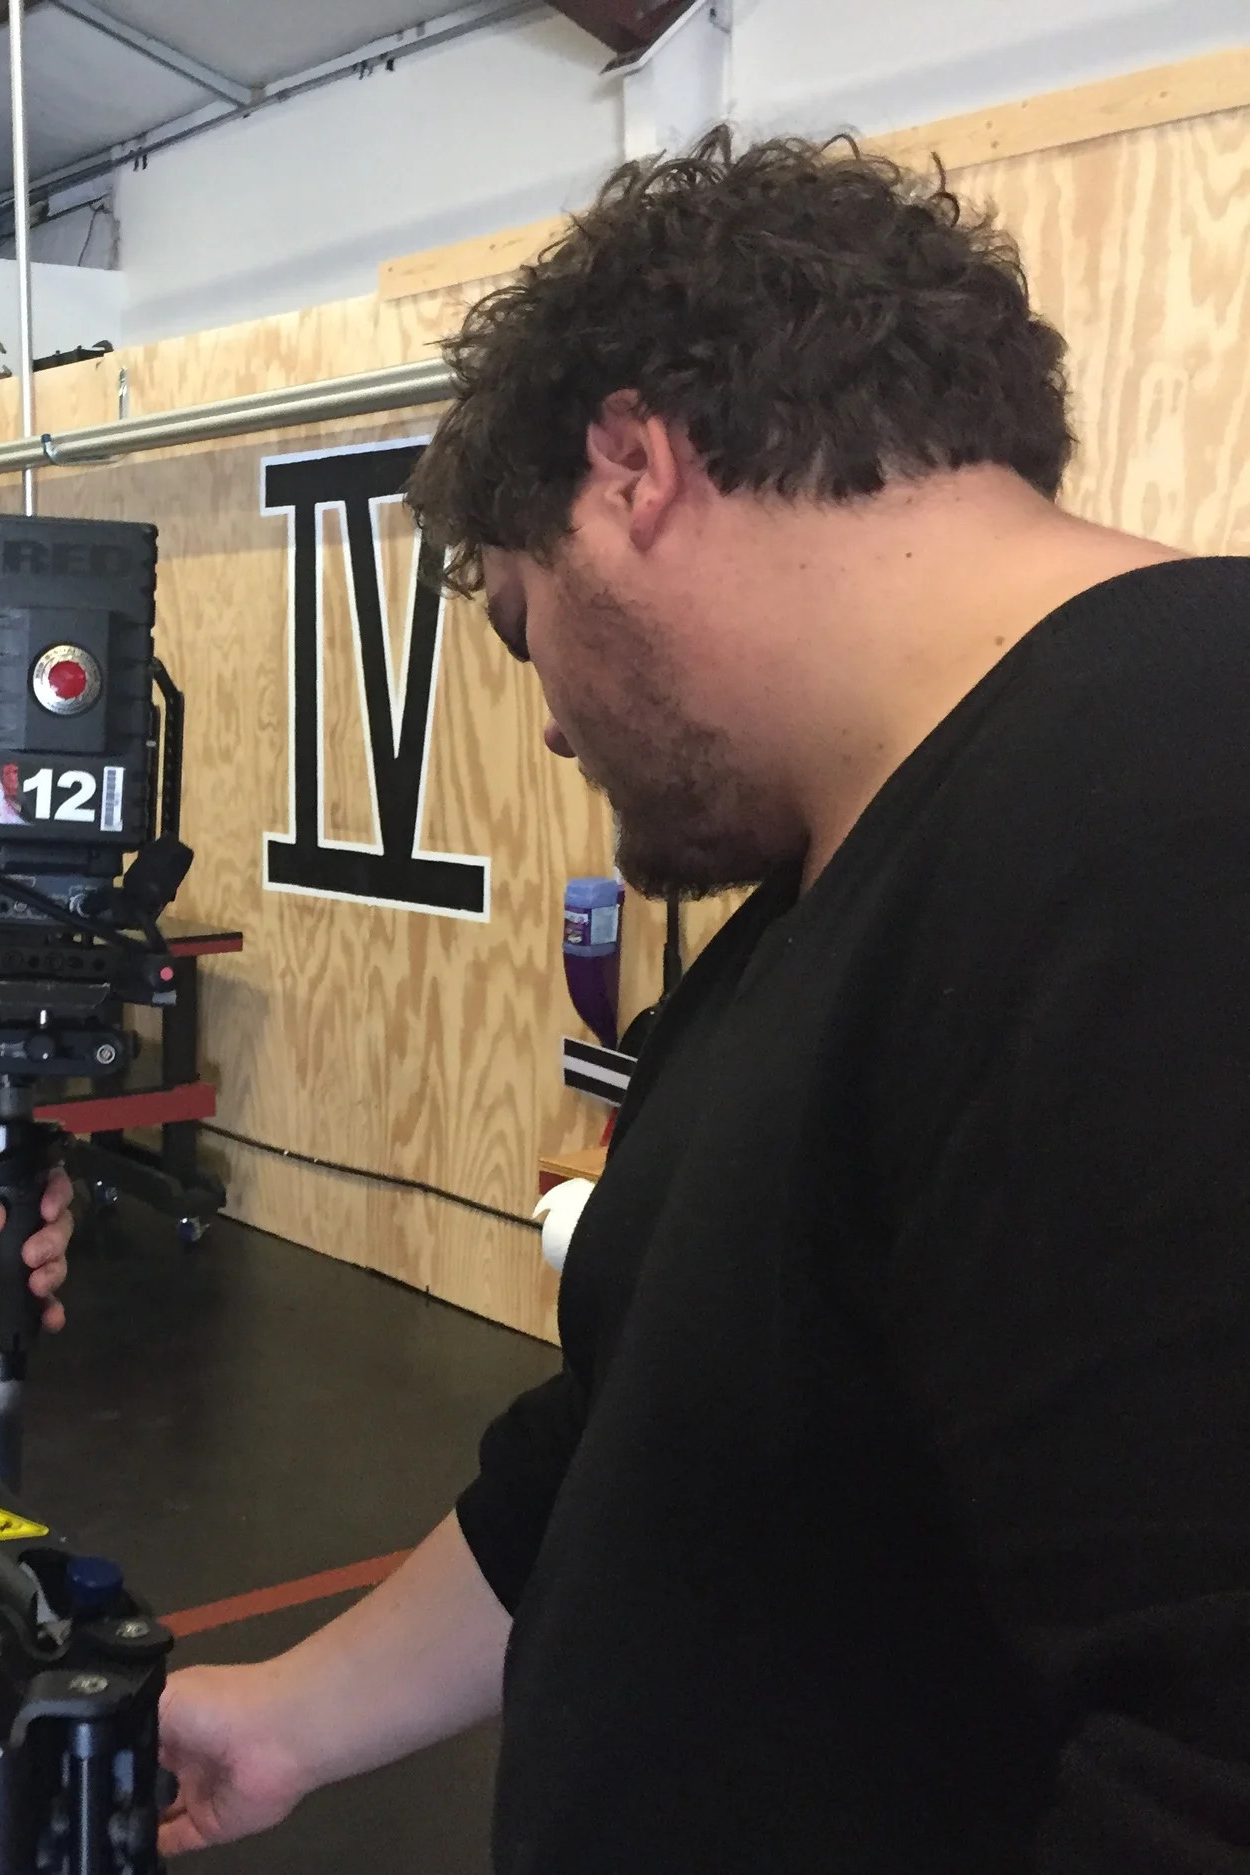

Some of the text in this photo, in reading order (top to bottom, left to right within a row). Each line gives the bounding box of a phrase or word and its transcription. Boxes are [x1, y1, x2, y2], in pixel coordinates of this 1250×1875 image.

[3, 540, 133, 578] RED
[260, 434, 491, 922] IV
[22, 767, 97, 823] 12
